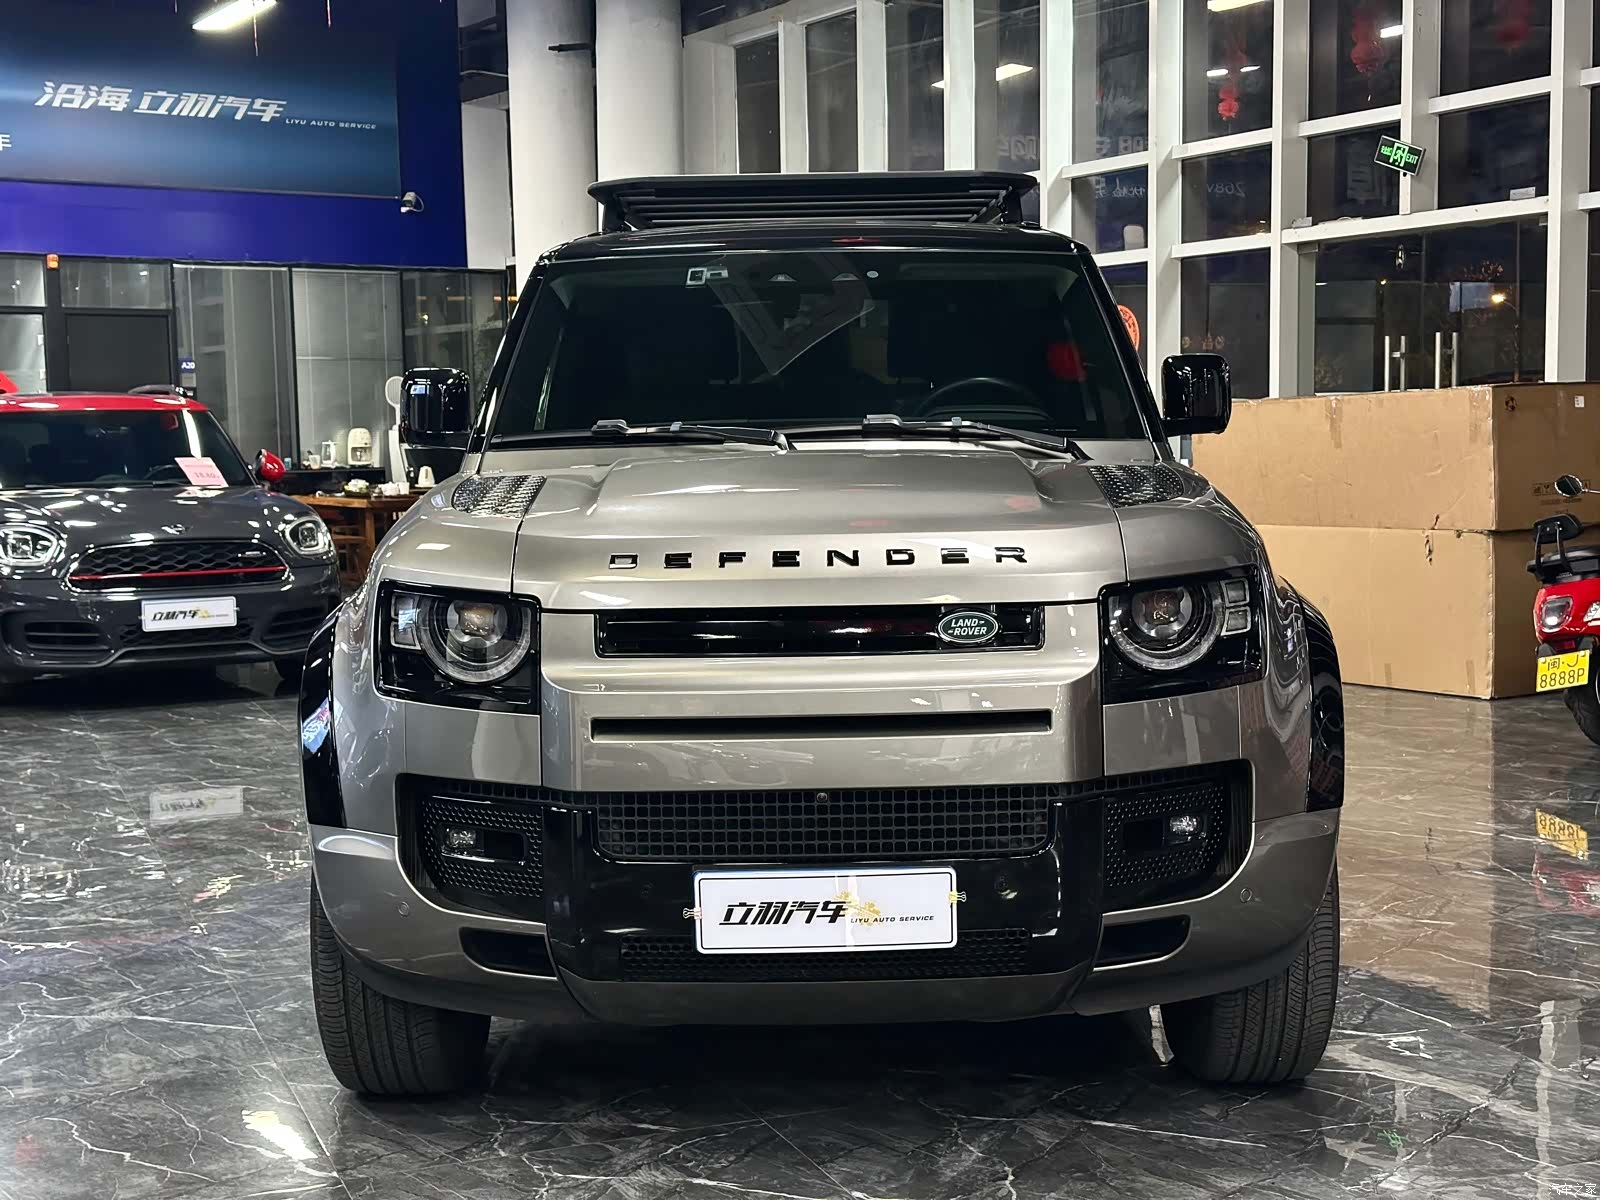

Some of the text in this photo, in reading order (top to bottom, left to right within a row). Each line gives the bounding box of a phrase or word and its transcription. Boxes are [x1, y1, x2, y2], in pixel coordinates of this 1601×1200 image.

[34, 81, 287, 122] 沿海 立羽汽车
[285, 118, 377, 130] LIYU AUTO SERVICE
[1406, 153, 1418, 164] EXIT
[181, 361, 195, 370] A20
[608, 546, 1028, 570] DEFENDER
[1540, 668, 1585, 688] 8888P
[719, 900, 849, 925] 立羽汽车
